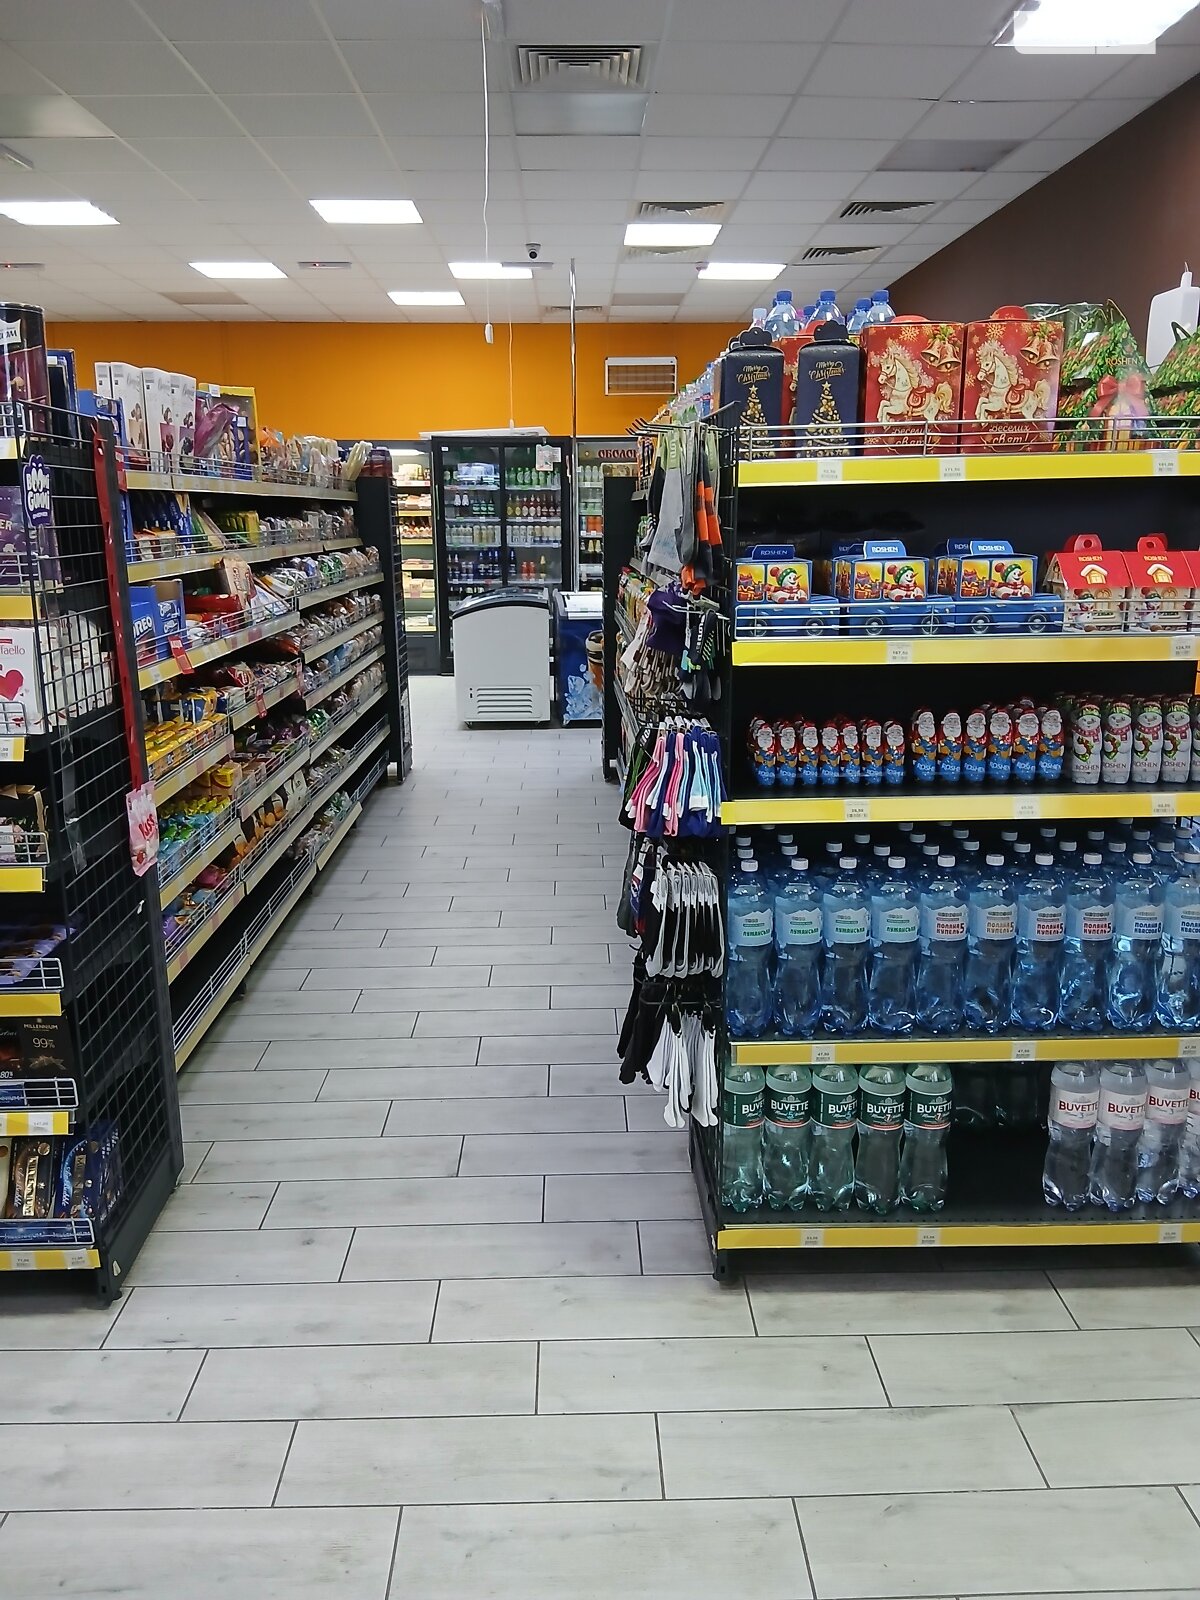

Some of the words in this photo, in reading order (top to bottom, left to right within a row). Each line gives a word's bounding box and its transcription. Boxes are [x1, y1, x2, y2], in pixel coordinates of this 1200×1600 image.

[816, 361, 843, 369] Merry
[1106, 357, 1138, 366] ROSHEN
[743, 365, 769, 373] Merry
[32, 1037, 56, 1049] 99%
[771, 1099, 809, 1111] BUVETTE
